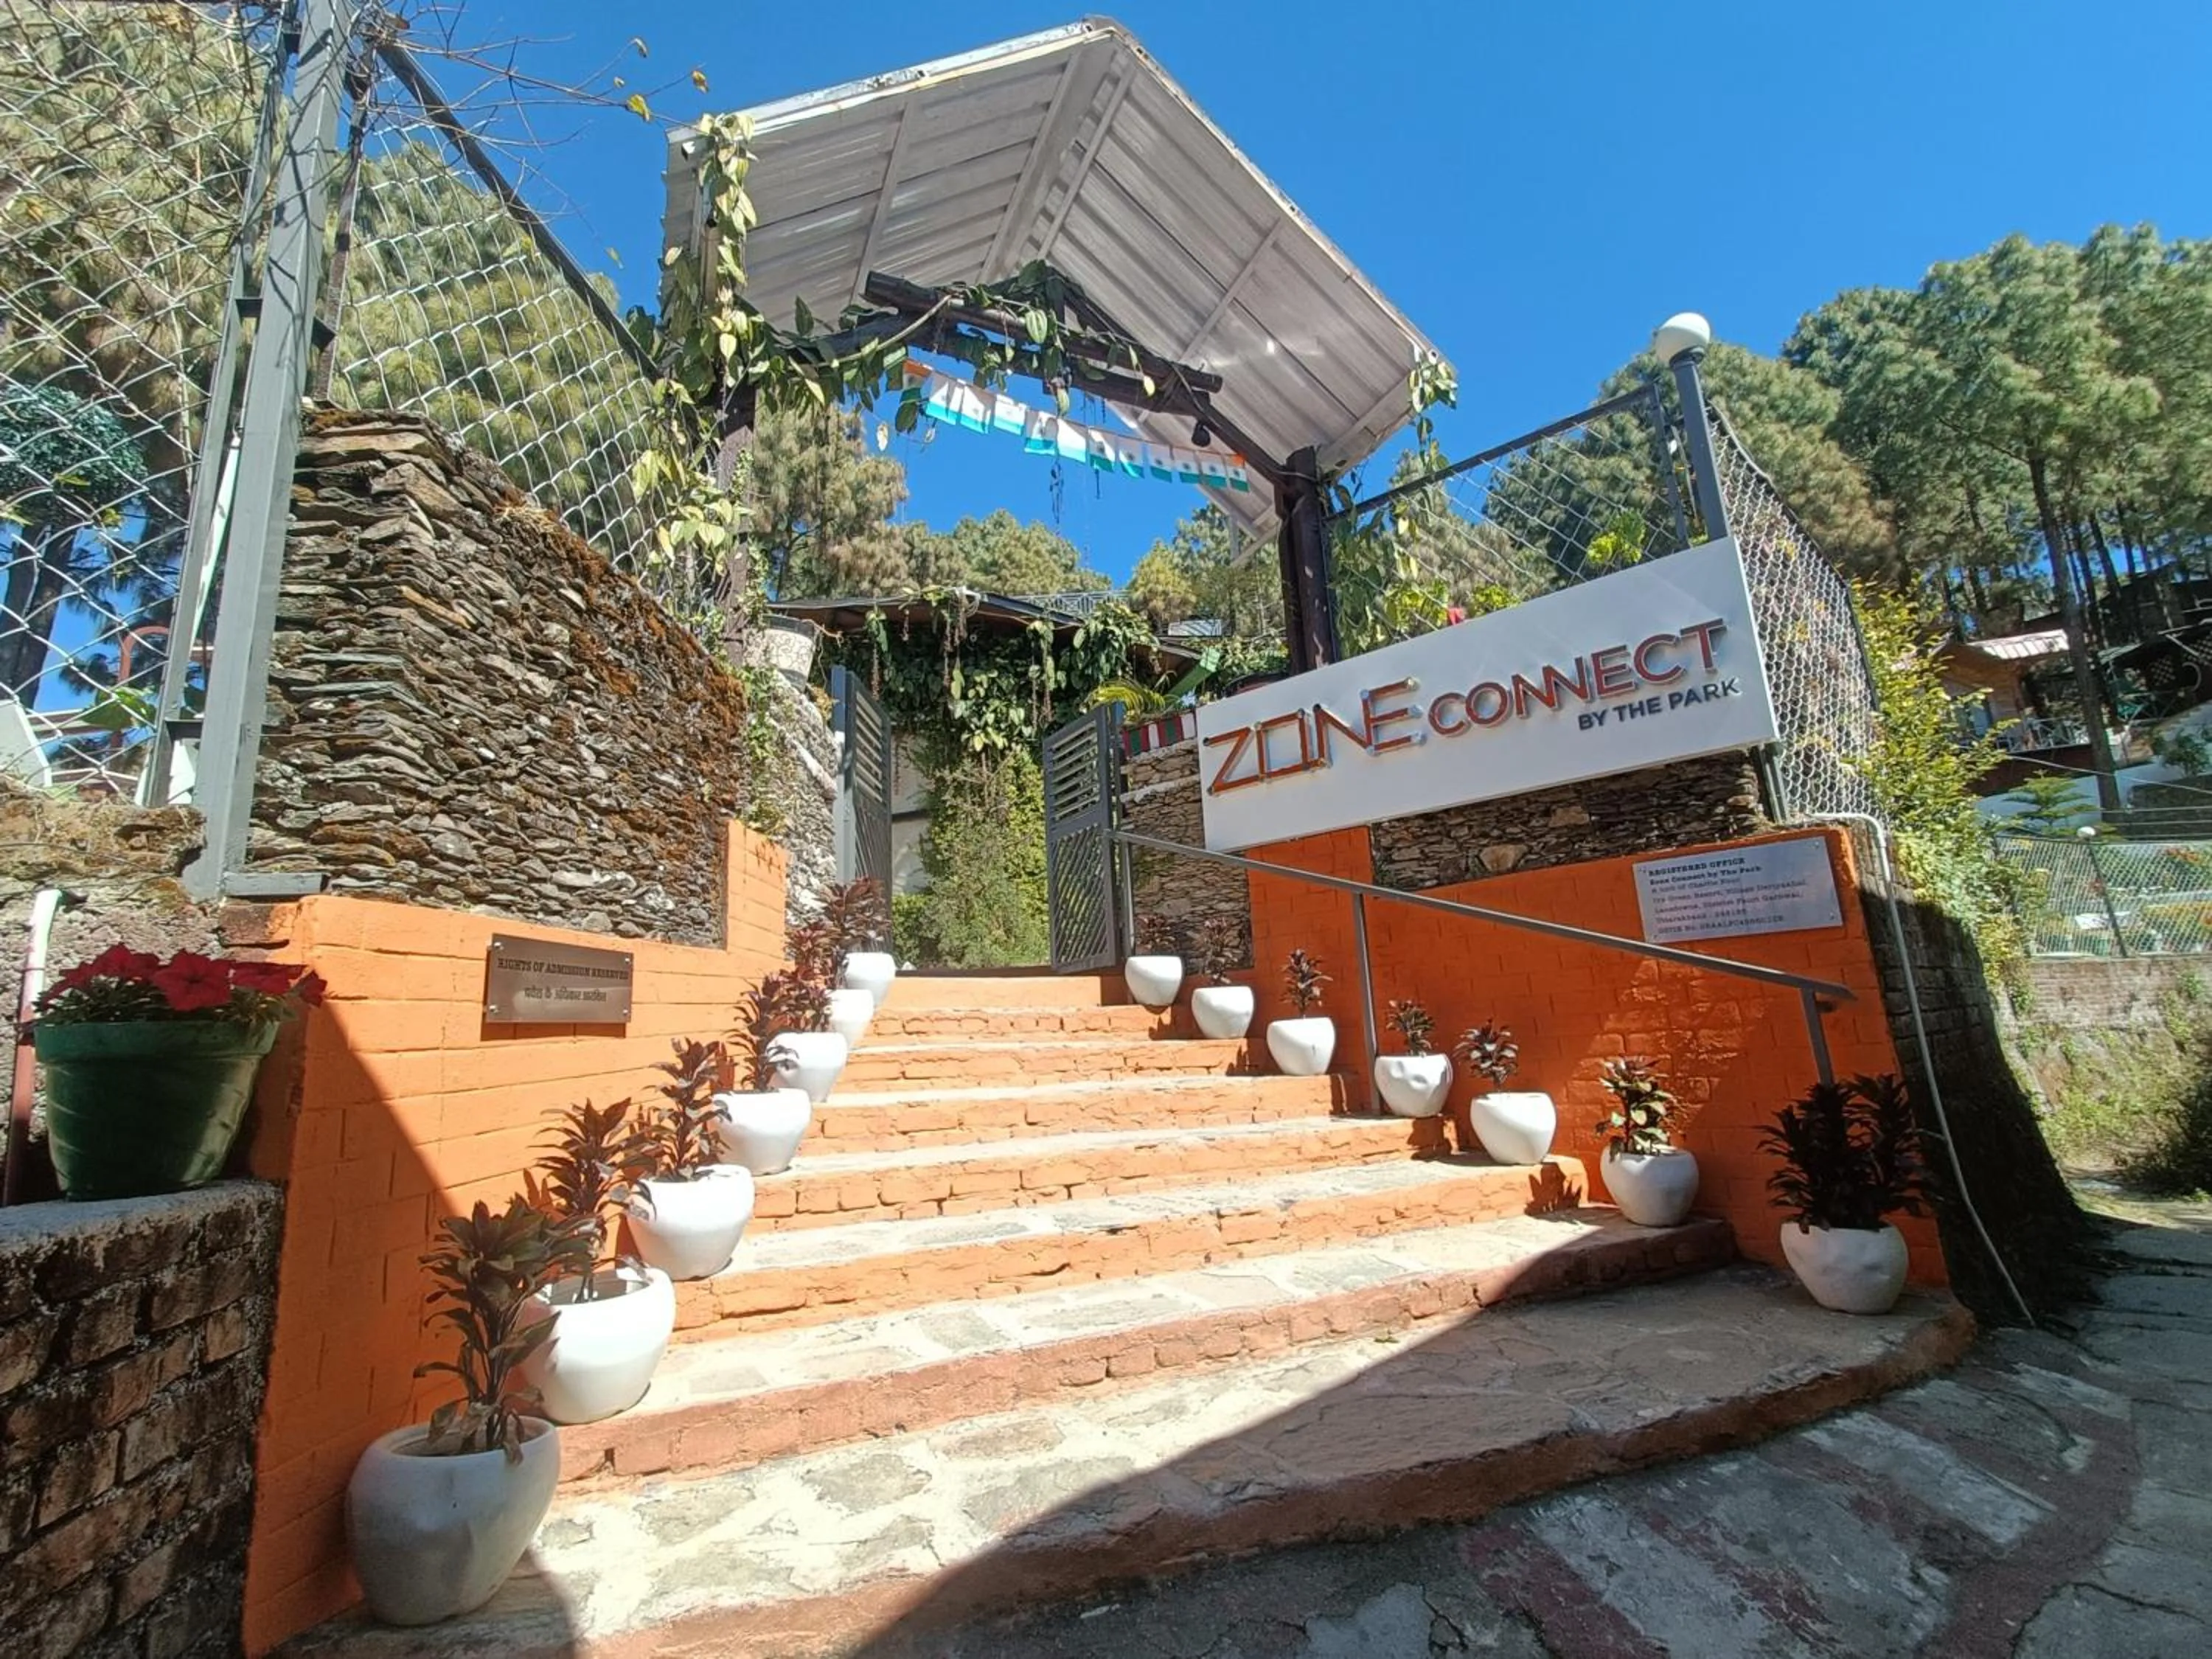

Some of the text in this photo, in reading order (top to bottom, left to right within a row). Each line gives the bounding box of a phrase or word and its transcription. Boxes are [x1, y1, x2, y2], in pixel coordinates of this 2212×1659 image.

[1203, 617, 1731, 796] ZONE CONNECT
[1577, 675, 1743, 731] BY THE PARK
[1648, 857, 1745, 876] REGISTERED OFFICE
[1719, 868, 1737, 876] The
[498, 958, 531, 971] RIGHTS
[533, 961, 545, 973] OF
